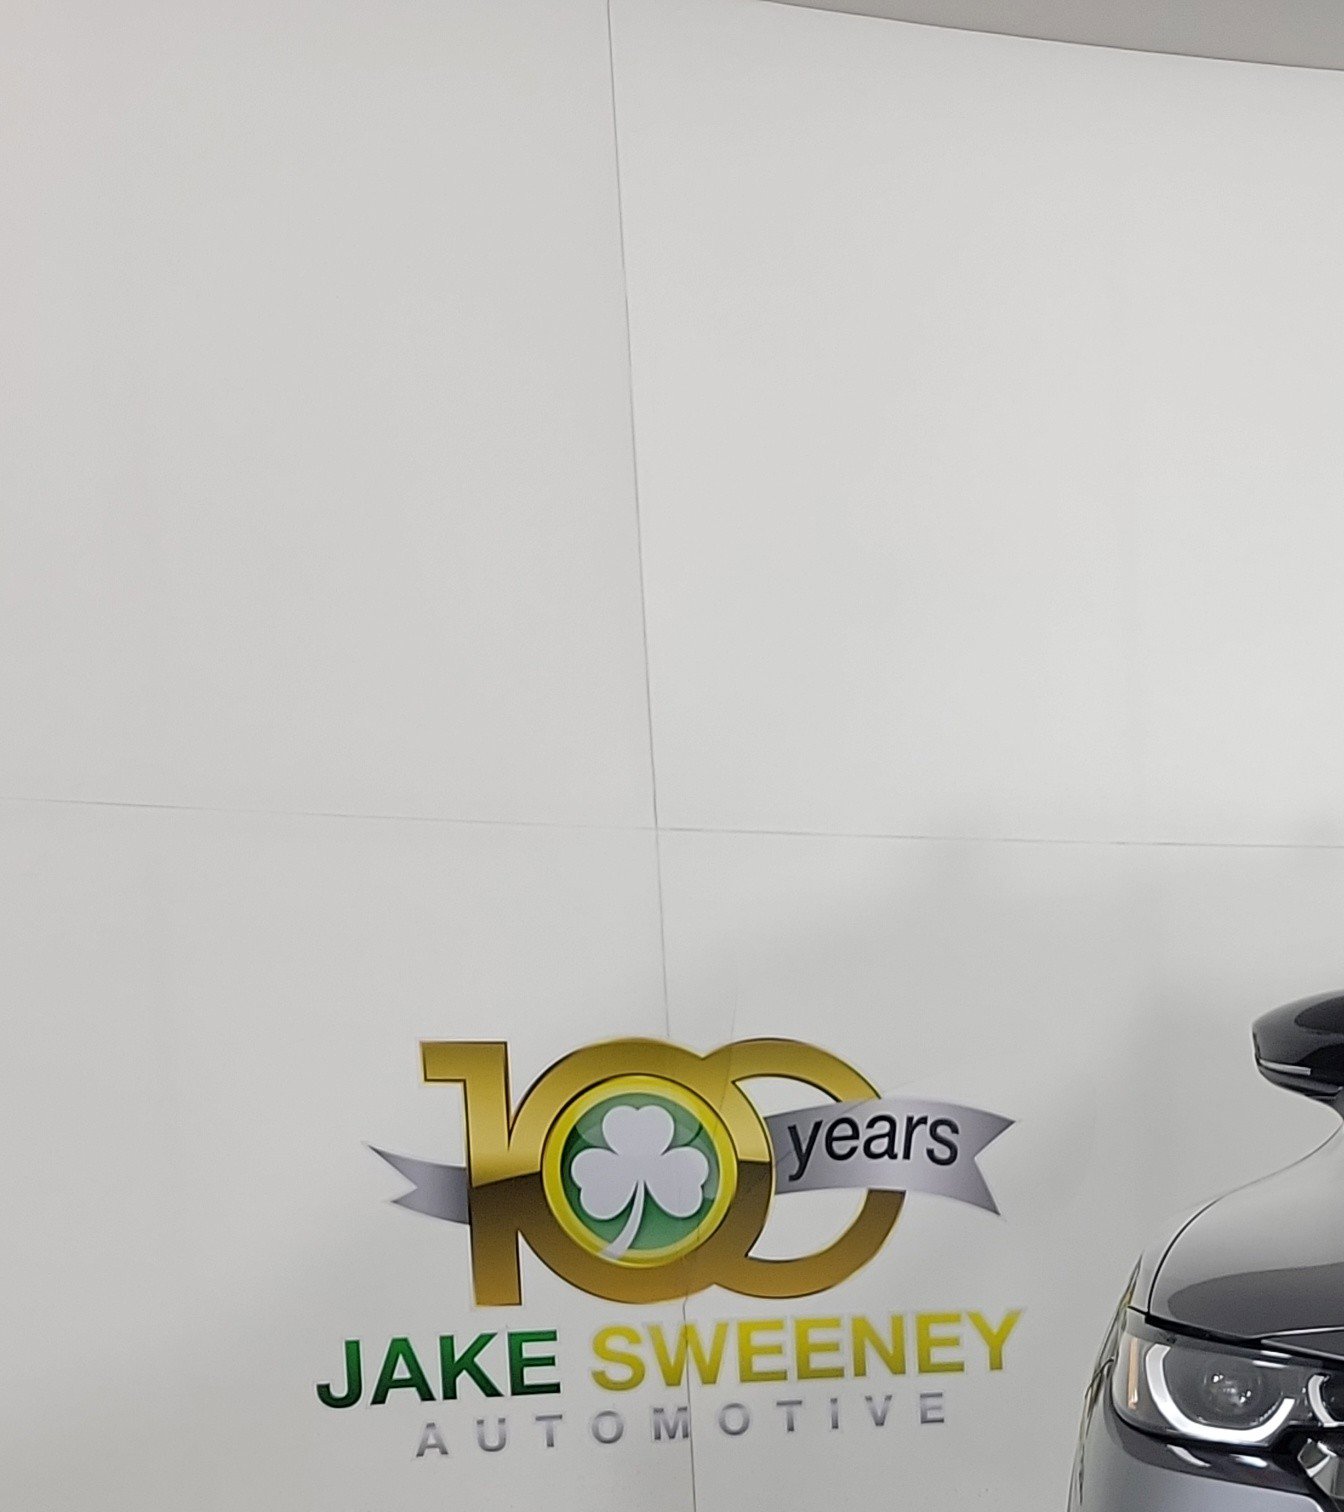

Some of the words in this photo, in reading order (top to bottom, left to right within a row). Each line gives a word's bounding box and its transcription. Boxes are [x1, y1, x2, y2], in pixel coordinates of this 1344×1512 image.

[419, 1037, 908, 1307] 100
[786, 1114, 961, 1182] years
[315, 1329, 562, 1410] JAKE
[590, 1309, 1024, 1392] SWEENEY
[414, 1391, 947, 1459] AUTOMOTIVE
